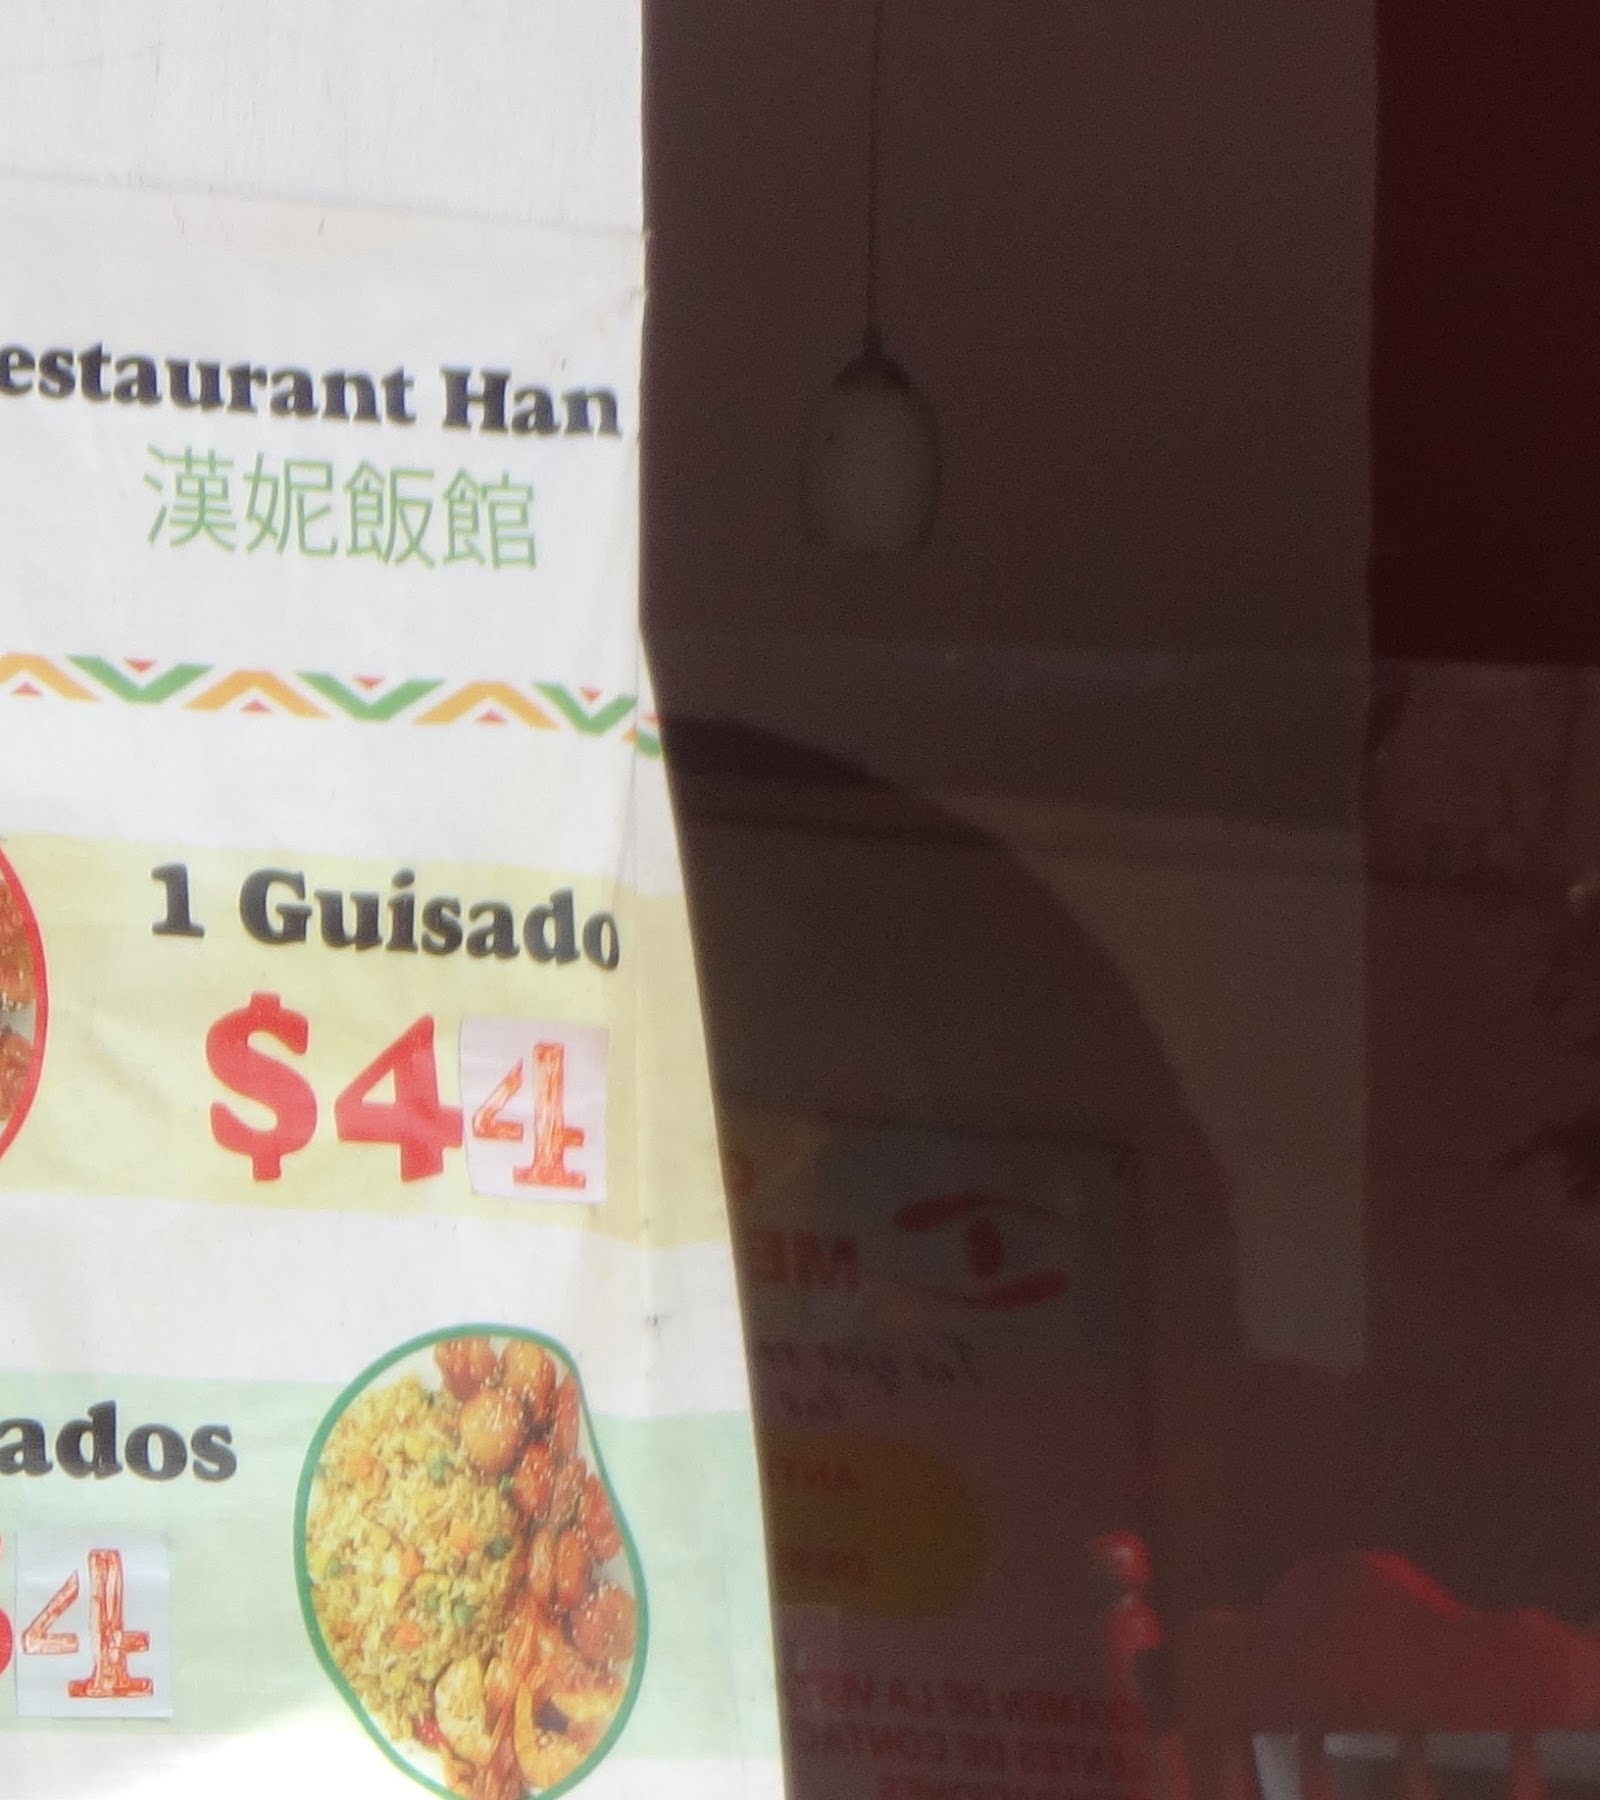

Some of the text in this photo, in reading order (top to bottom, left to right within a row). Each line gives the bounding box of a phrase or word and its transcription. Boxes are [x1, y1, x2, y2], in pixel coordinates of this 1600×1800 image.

[439, 366, 624, 440] Han
[141, 443, 539, 571] 漢妮飯館
[150, 861, 622, 971] 1 Guisado
[204, 990, 587, 1192] $44
